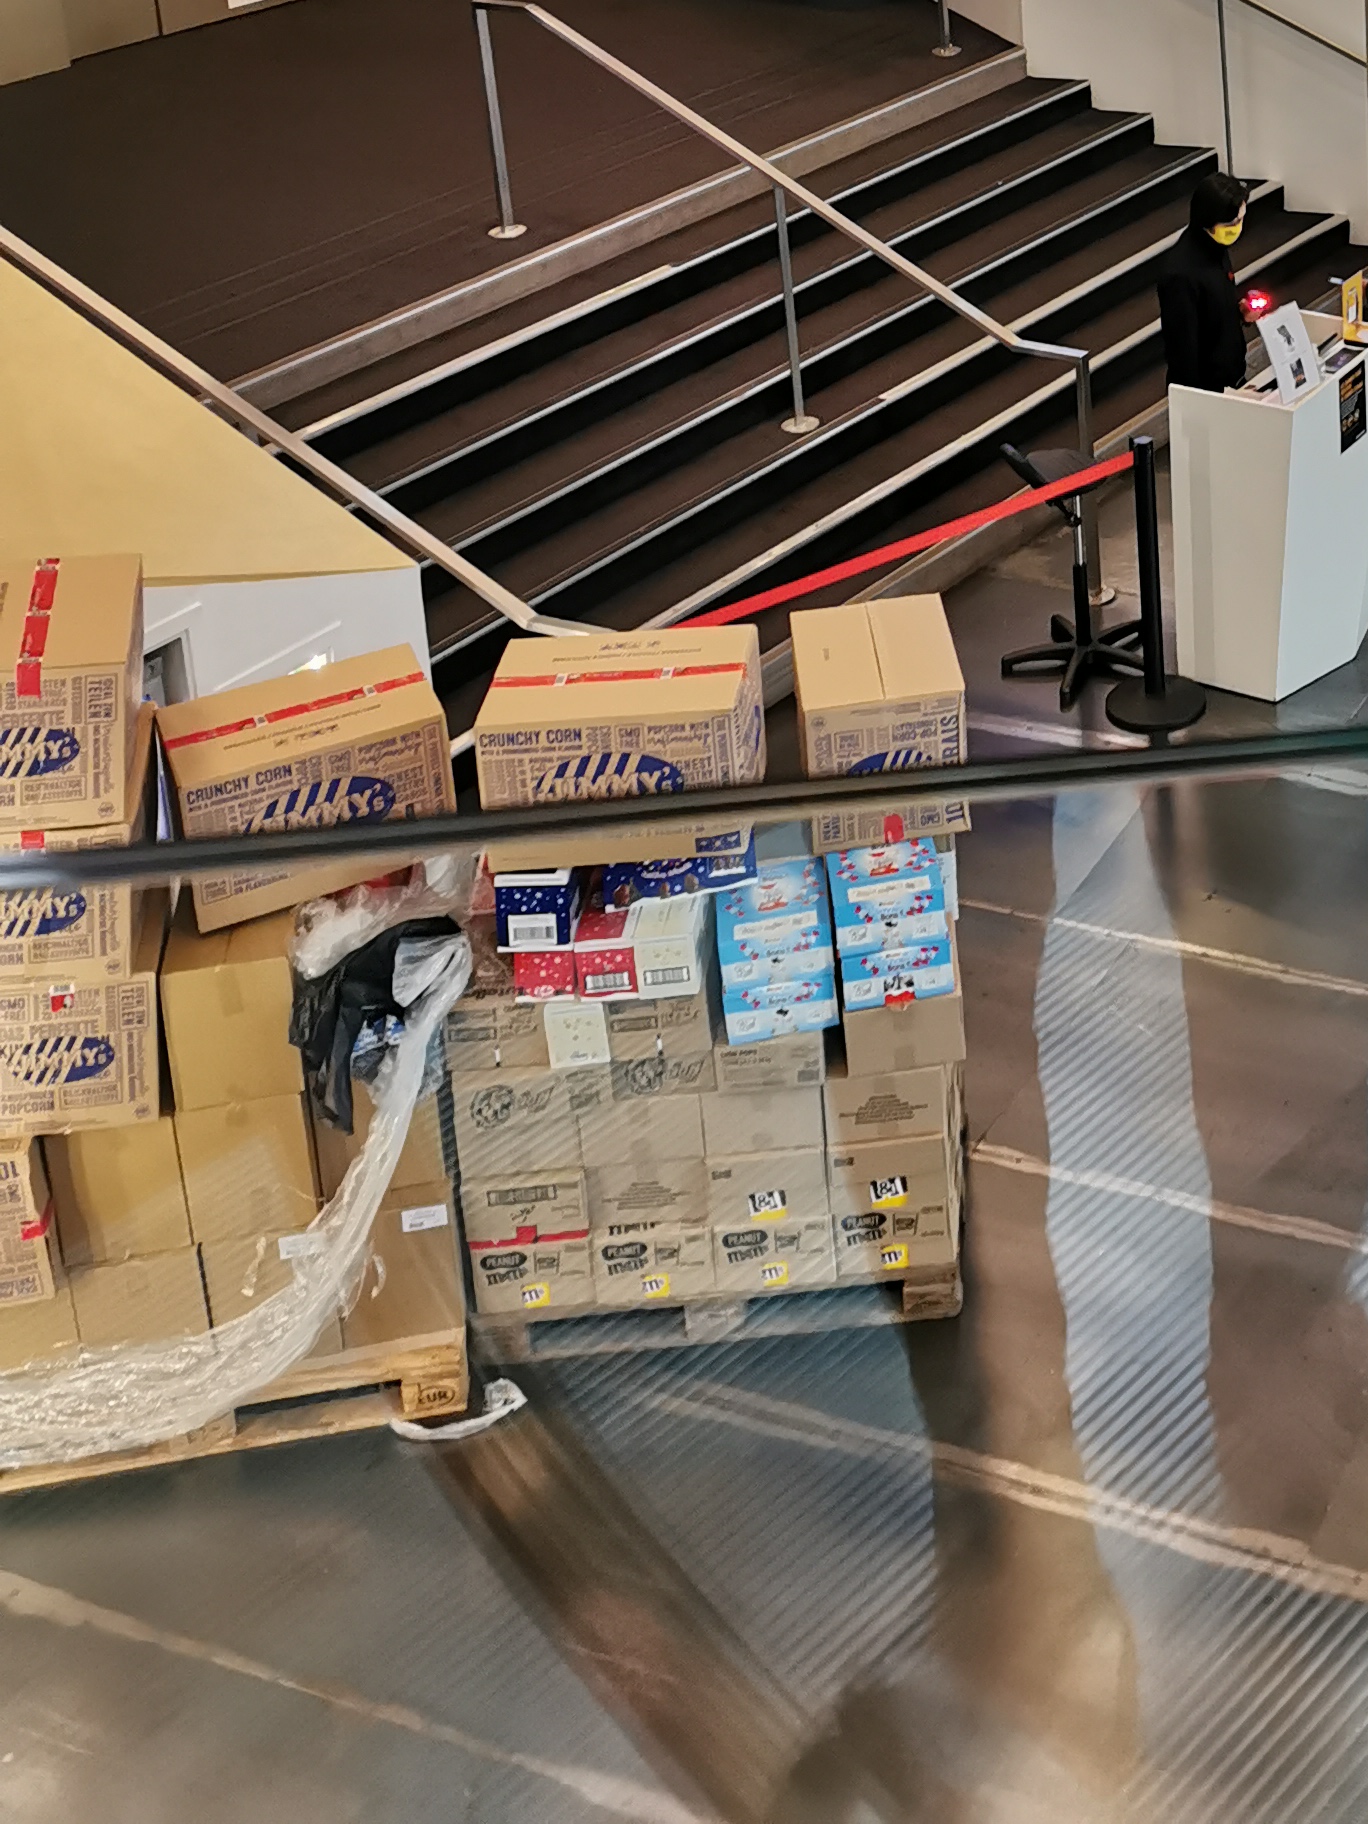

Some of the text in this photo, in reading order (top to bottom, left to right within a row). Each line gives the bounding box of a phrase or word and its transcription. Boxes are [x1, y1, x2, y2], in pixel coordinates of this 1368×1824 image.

[88, 680, 102, 719] TEILEN
[478, 729, 542, 749] CRUNCHY
[545, 727, 582, 745] CORN
[186, 762, 293, 805] CRUNCHY CORN
[121, 987, 135, 1026] TEILEN
[1, 1099, 55, 1116] POPCORN
[847, 1216, 880, 1231] PEANUT
[728, 1230, 761, 1246] PEANUT
[607, 1243, 641, 1259] PEANUT
[485, 1254, 520, 1268] PEANUT
